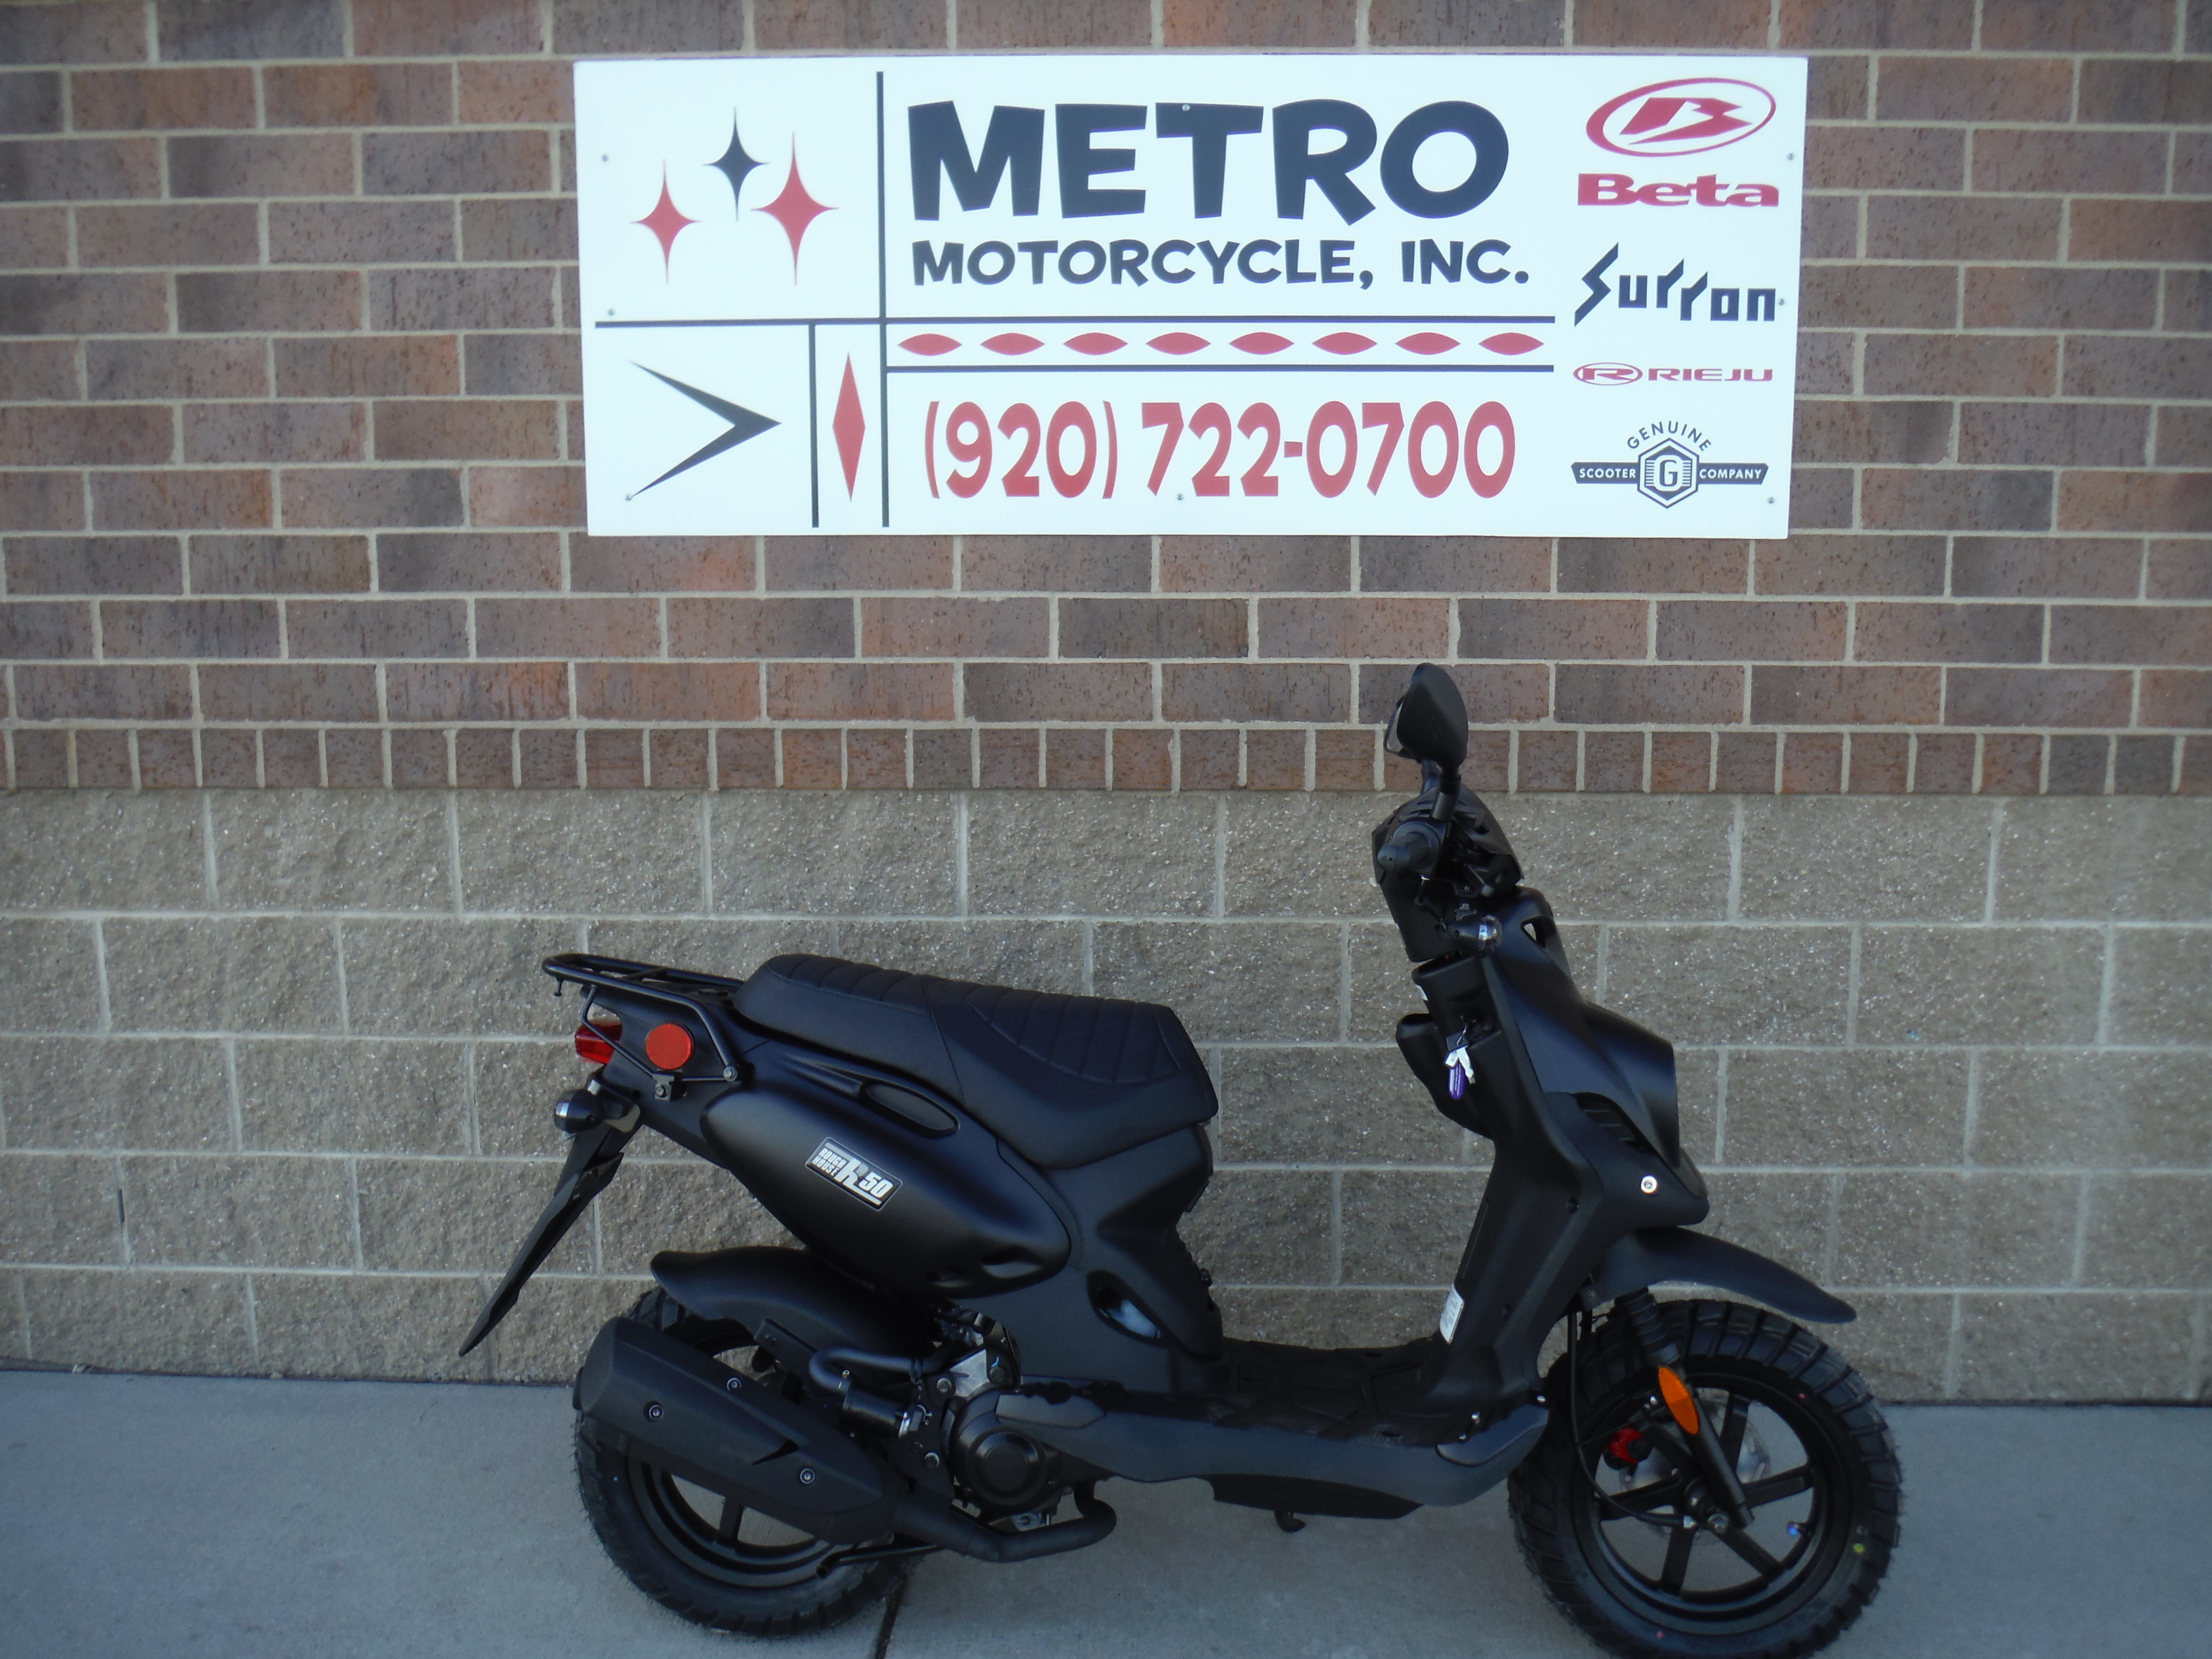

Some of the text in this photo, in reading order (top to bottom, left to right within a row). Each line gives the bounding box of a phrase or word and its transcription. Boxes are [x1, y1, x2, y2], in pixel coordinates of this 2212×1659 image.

[907, 98, 1509, 226] METRO
[1577, 173, 1779, 207] Beta
[912, 239, 1530, 291] MOTORCYCLE, INC.
[1647, 368, 1773, 382] RIEJU
[925, 401, 1515, 499] (920) 722-0700
[1626, 421, 1712, 452] GENUINE
[1579, 468, 1637, 478] SCOOTER
[1699, 468, 1762, 479] COMPANY
[811, 1155, 840, 1176] HOUSE
[818, 1147, 847, 1169] ROUGH
